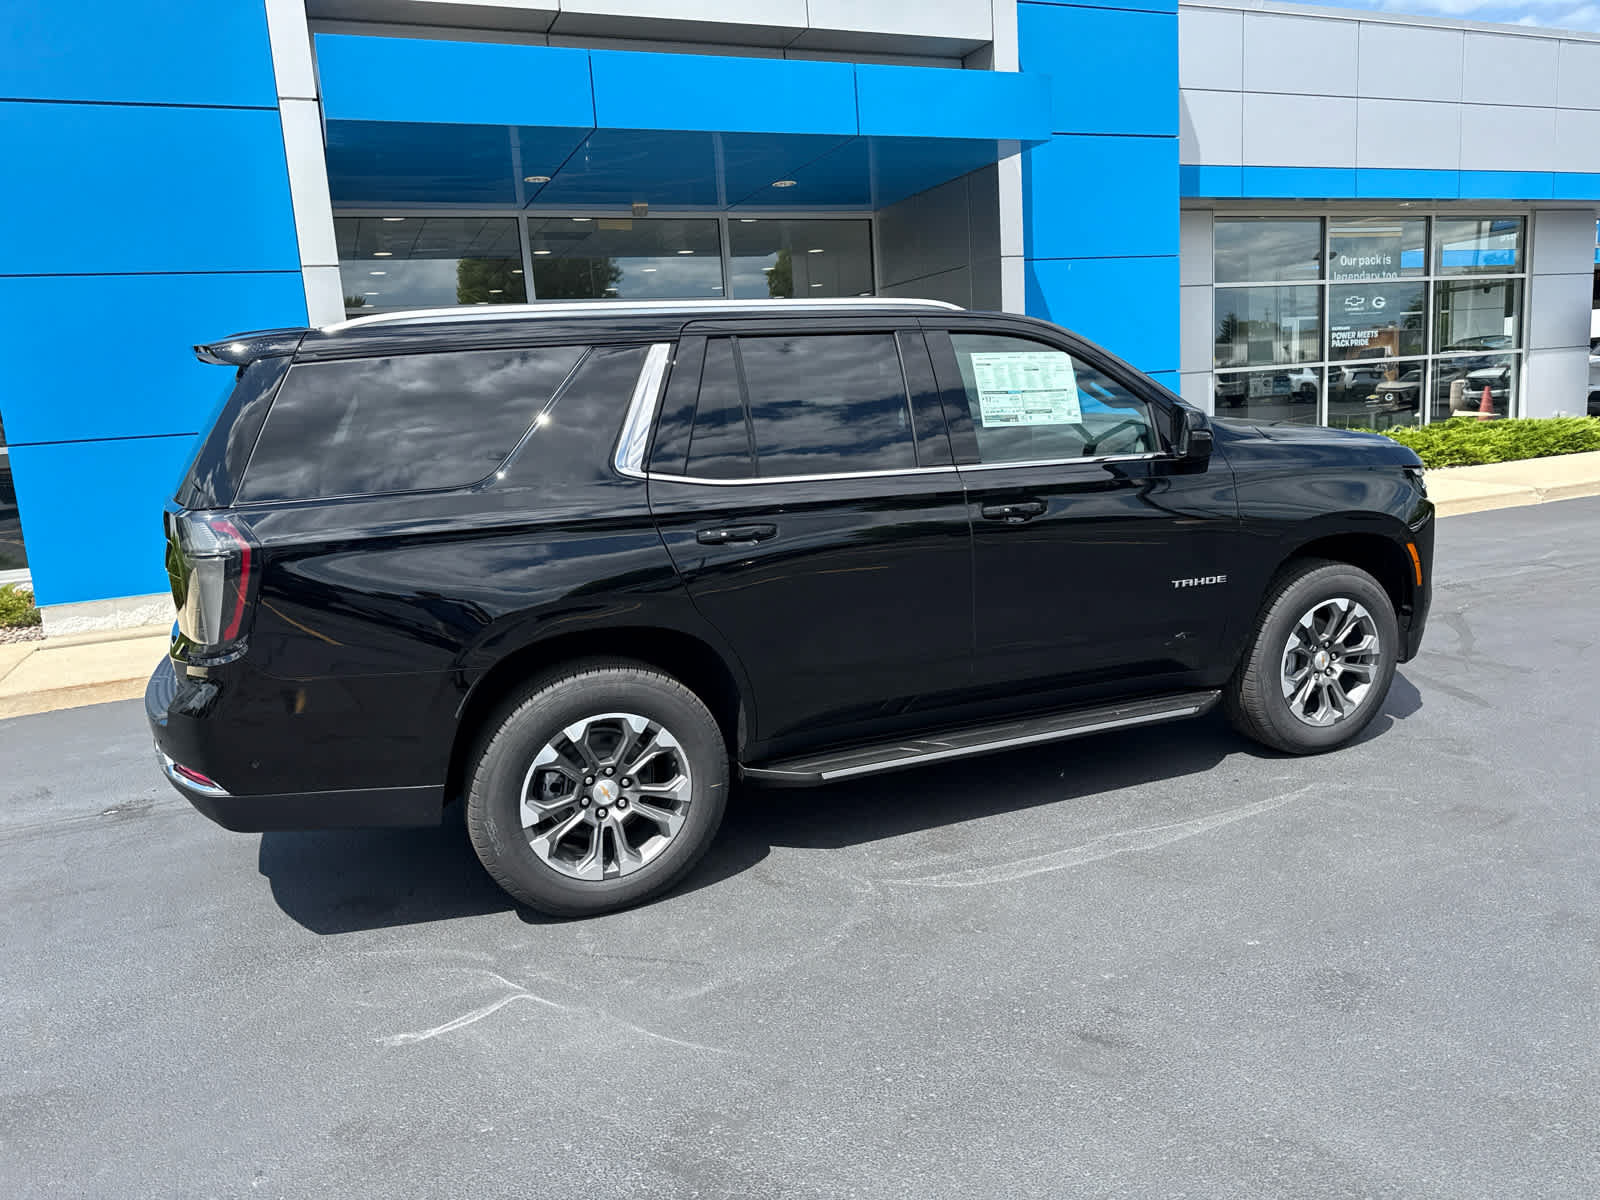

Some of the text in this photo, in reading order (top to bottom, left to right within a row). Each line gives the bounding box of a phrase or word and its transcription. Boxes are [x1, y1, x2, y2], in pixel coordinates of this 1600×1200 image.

[1340, 254, 1392, 268] Our pack is
[1331, 330, 1378, 340] POWER MEETS
[1331, 338, 1369, 348] PACK PRIDE
[1171, 573, 1228, 589] TAHOE
